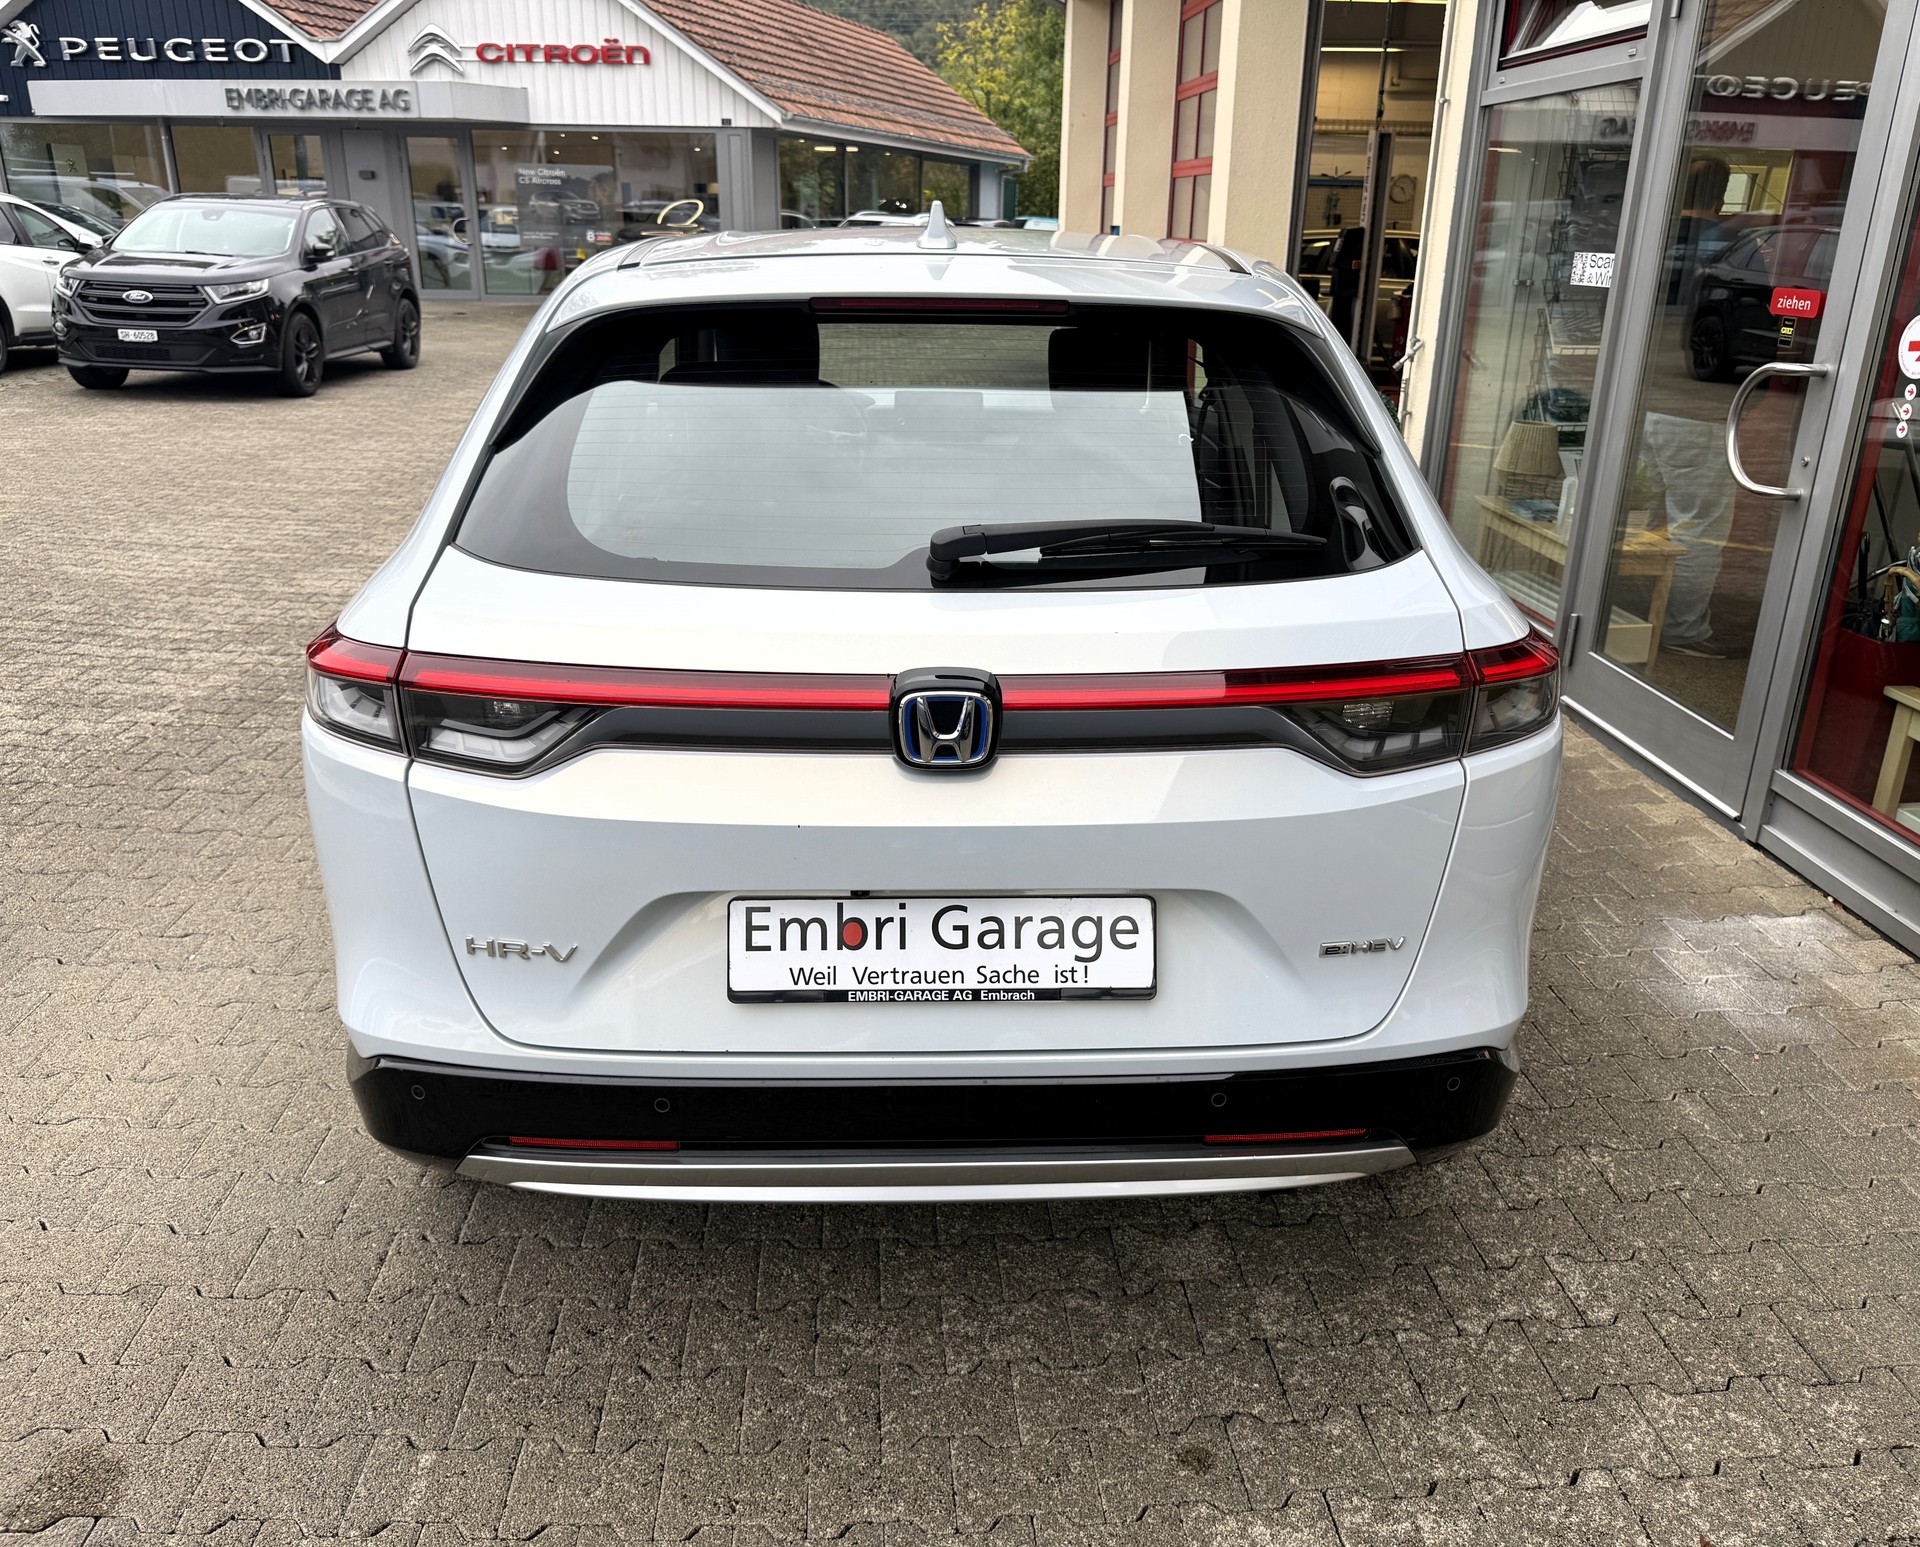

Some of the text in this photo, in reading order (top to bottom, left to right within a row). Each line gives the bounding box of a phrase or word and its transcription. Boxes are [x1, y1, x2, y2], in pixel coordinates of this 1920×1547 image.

[59, 37, 296, 63] PEUGEOT
[225, 88, 411, 112] EMBRI-GARAGE AG
[1777, 295, 1811, 311] ziehen
[745, 902, 1140, 963] Embri Garage
[466, 935, 578, 963] HR-V
[789, 967, 838, 986] Weil
[852, 966, 965, 986] Vertrauen
[976, 964, 1040, 985] Sache
[848, 990, 1035, 1002] EMBRI-GARAGE AG Embrach
